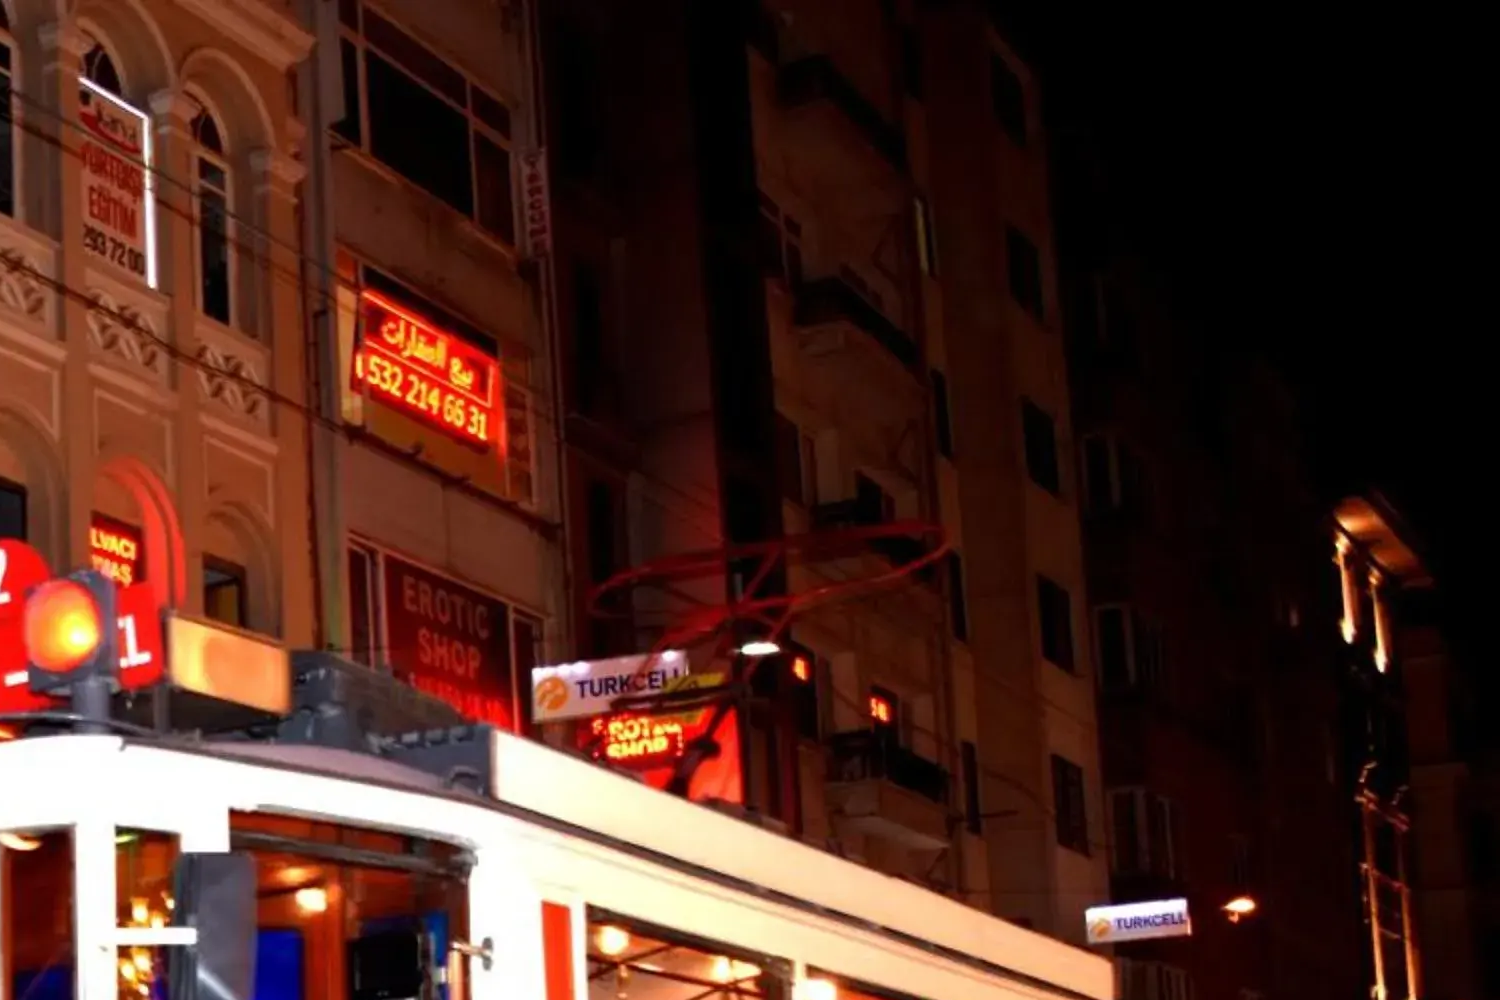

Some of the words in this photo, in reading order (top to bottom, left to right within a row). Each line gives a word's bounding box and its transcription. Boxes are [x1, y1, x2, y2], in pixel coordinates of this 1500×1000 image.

[367, 355, 403, 397] 532
[405, 374, 440, 415] 214
[443, 394, 466, 428] 66
[467, 405, 488, 441] 31
[402, 574, 490, 640] EROTIC
[418, 626, 482, 680] SHOP
[1114, 911, 1186, 930] TURKCELL
